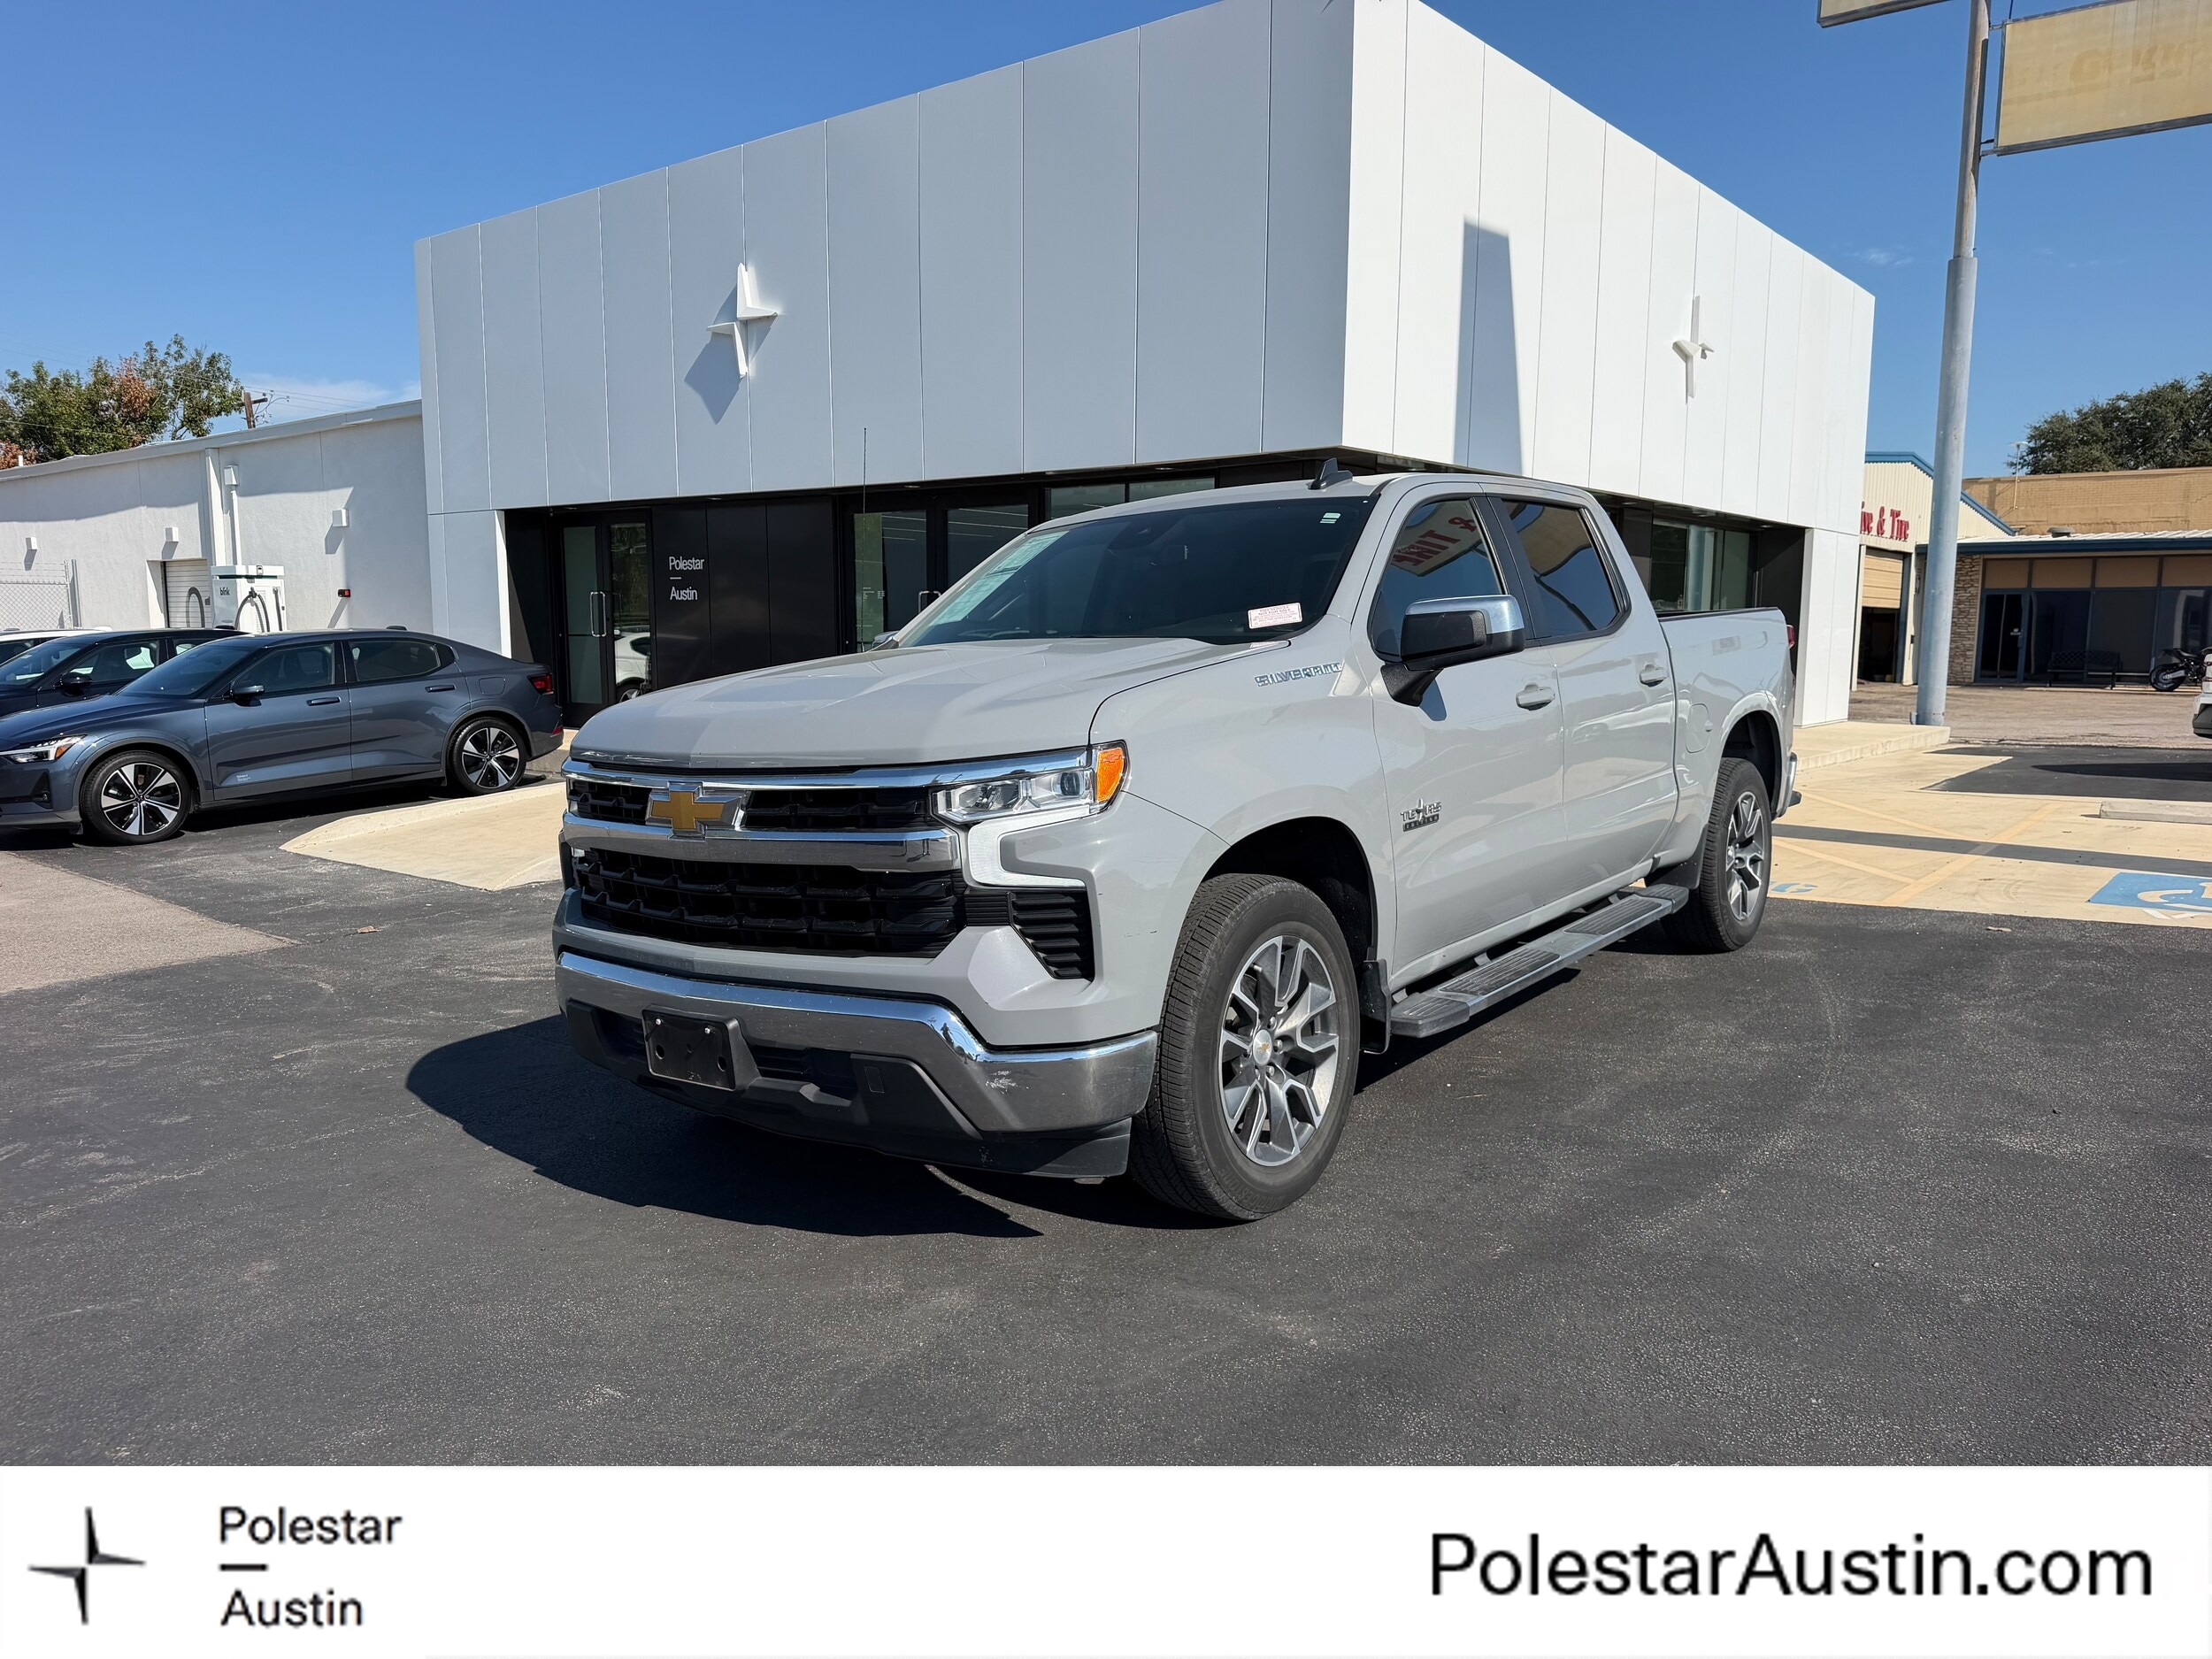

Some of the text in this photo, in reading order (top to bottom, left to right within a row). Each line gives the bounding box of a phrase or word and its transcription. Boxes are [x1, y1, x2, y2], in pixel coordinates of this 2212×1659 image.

[1877, 506, 1886, 535] &
[1890, 509, 1909, 541] Tire
[669, 557, 704, 571] Polestar
[670, 587, 698, 601] Austin
